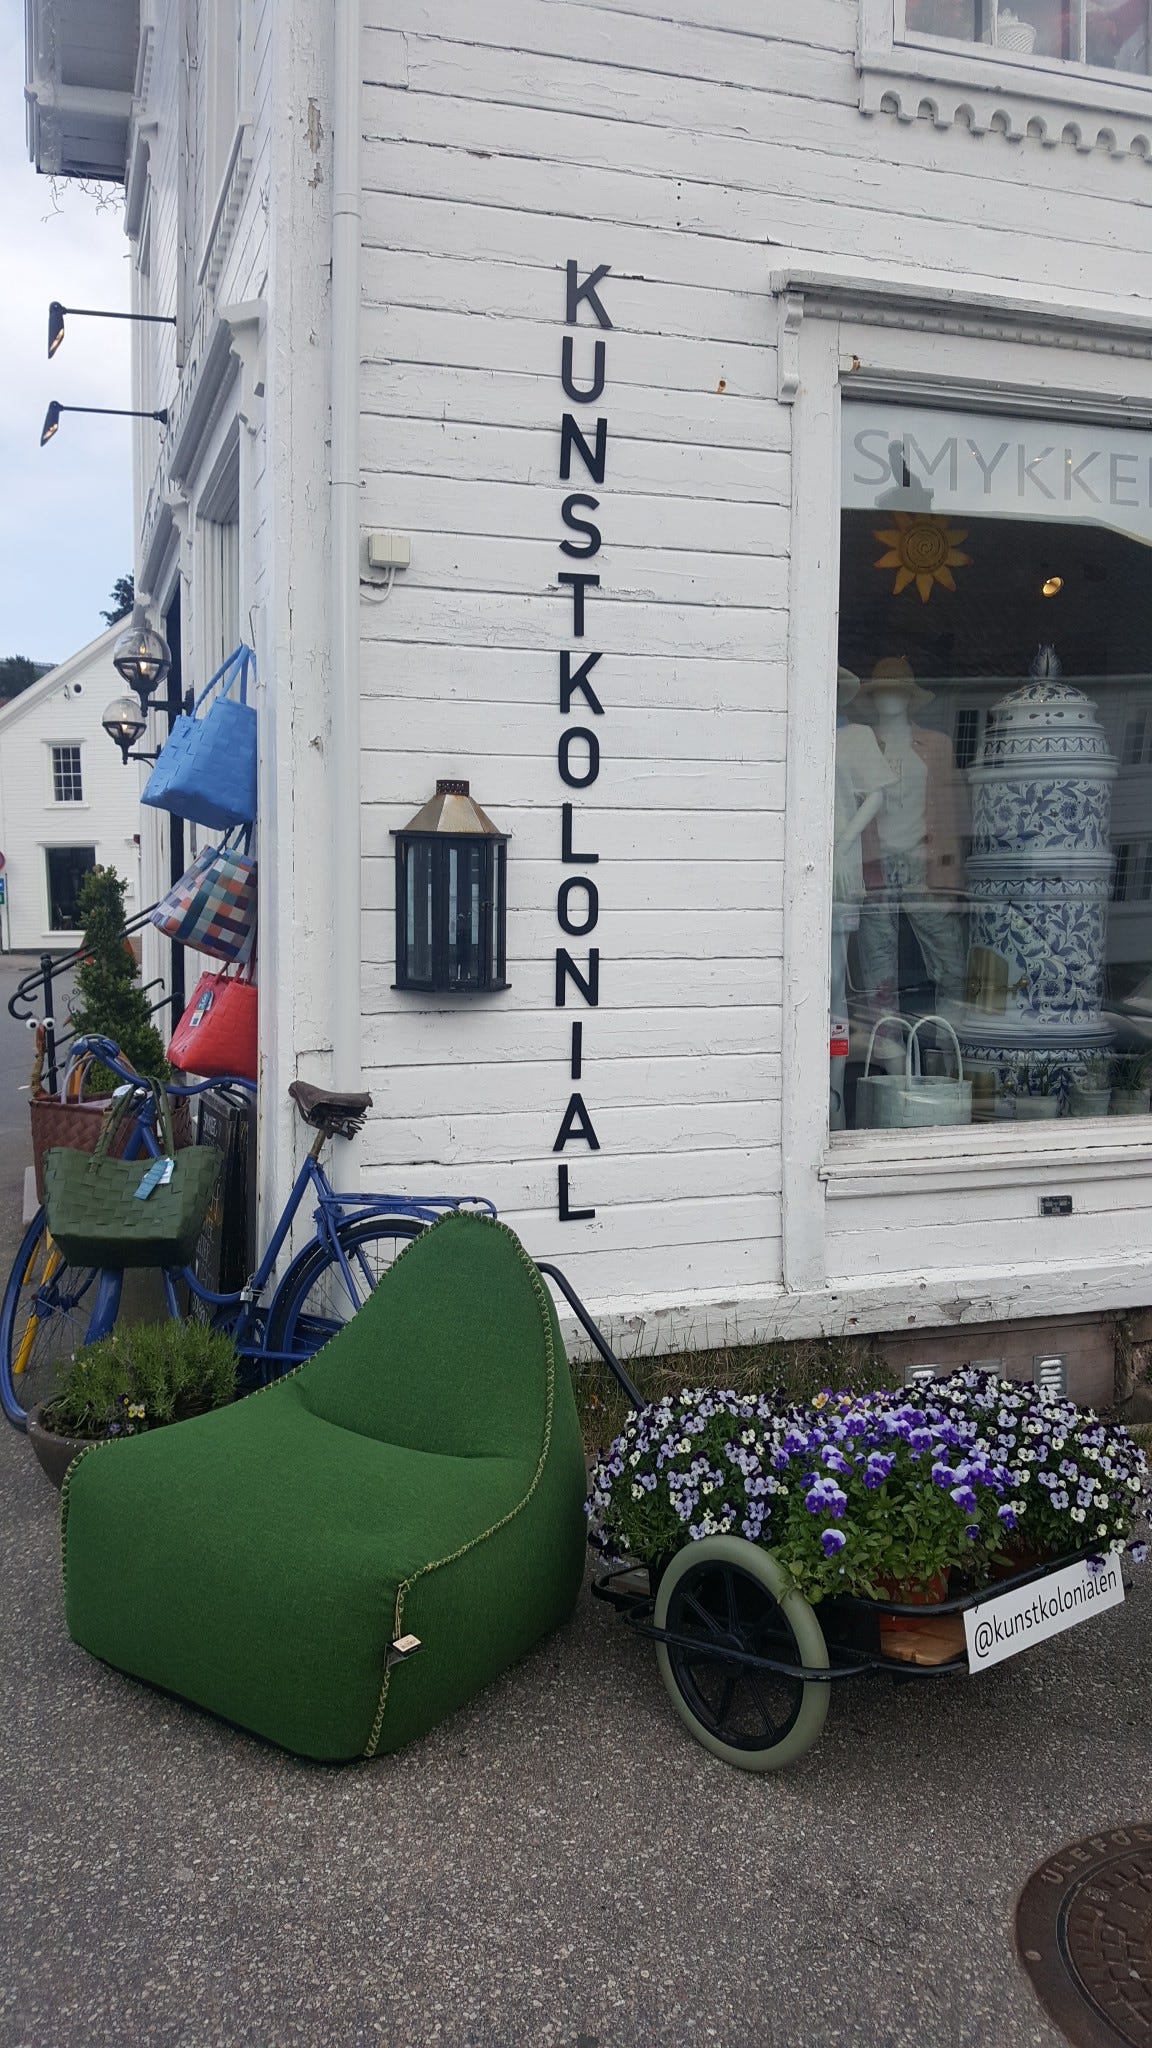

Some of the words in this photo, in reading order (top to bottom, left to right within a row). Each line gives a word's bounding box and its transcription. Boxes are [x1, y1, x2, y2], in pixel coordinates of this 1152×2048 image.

[852, 428, 1152, 508] SMYKKE
[553, 259, 614, 1221] KUNSTKOLONIAL
[974, 1570, 1118, 1658] @kunstkolonialen
